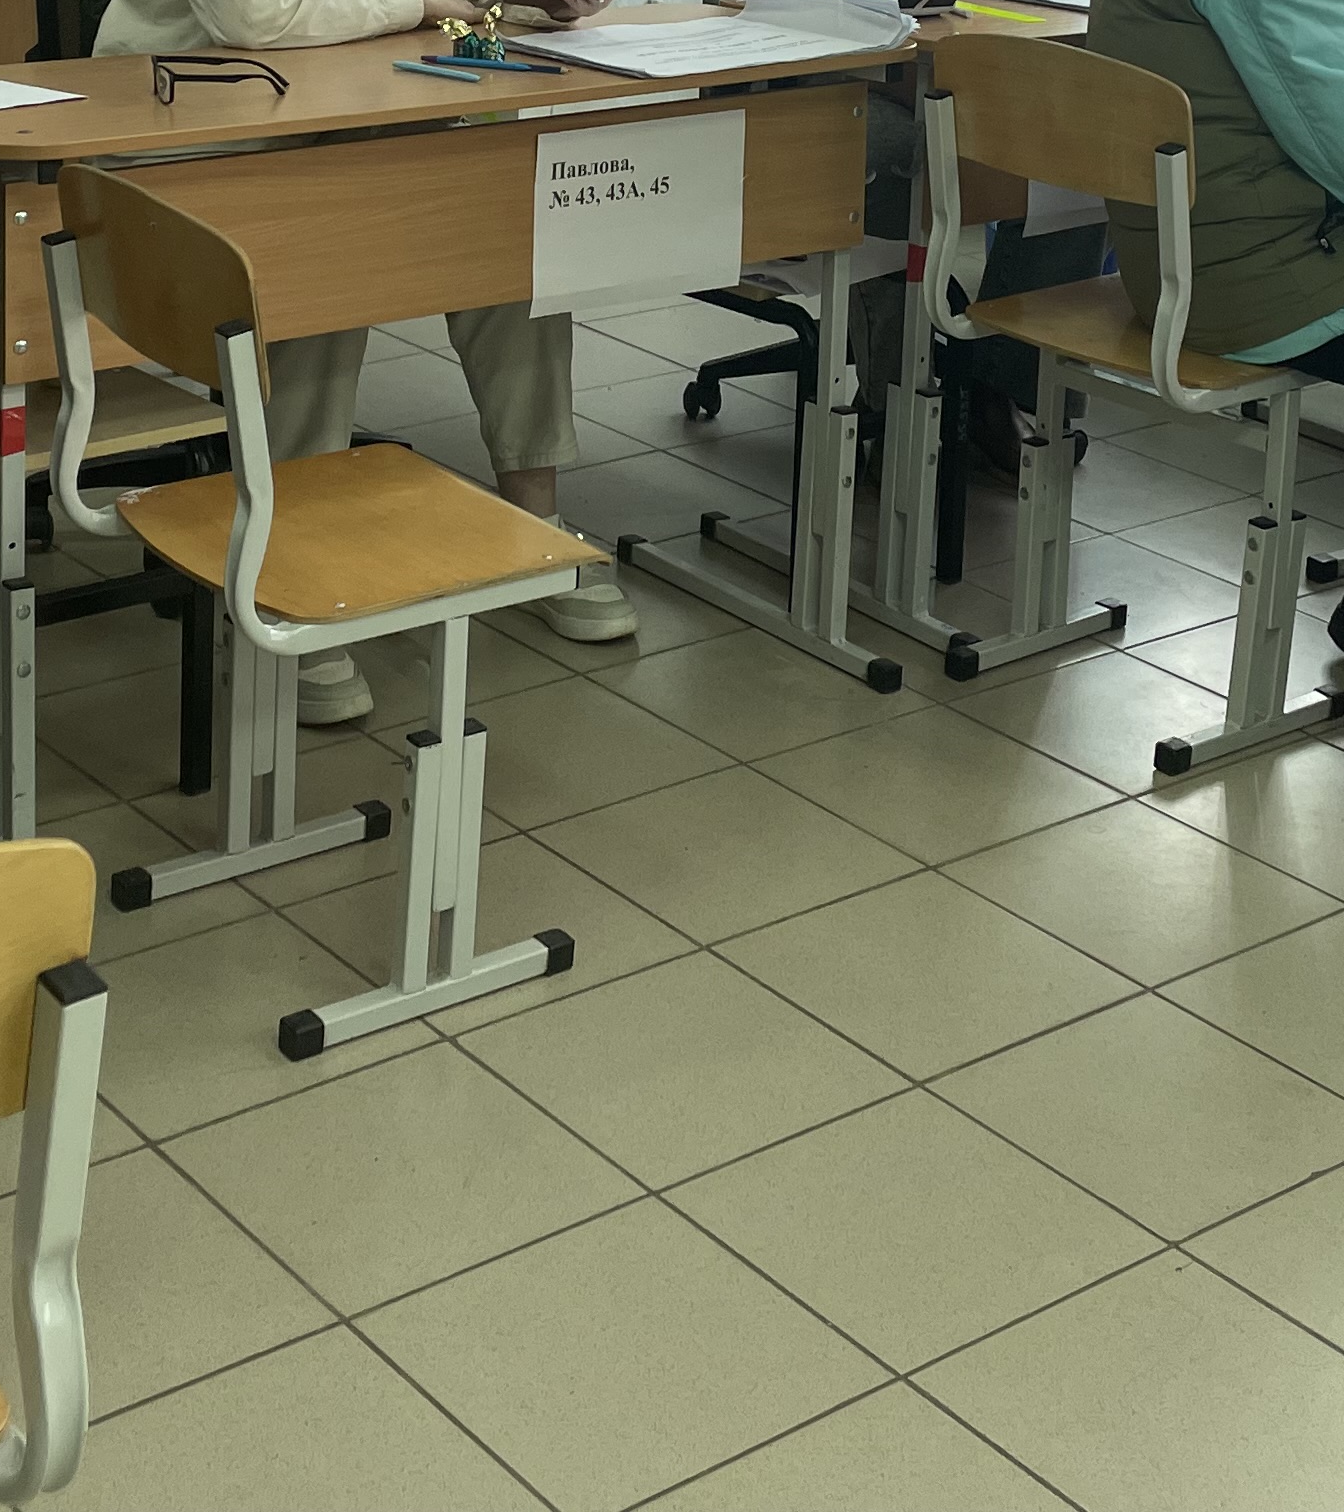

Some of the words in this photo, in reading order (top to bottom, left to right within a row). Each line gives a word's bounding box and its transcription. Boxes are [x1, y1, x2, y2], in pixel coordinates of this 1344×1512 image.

[551, 158, 635, 181] Павлова,
[548, 189, 570, 210] №
[575, 186, 601, 207] 43,
[606, 181, 645, 201] 43А,
[650, 175, 670, 196] 45
